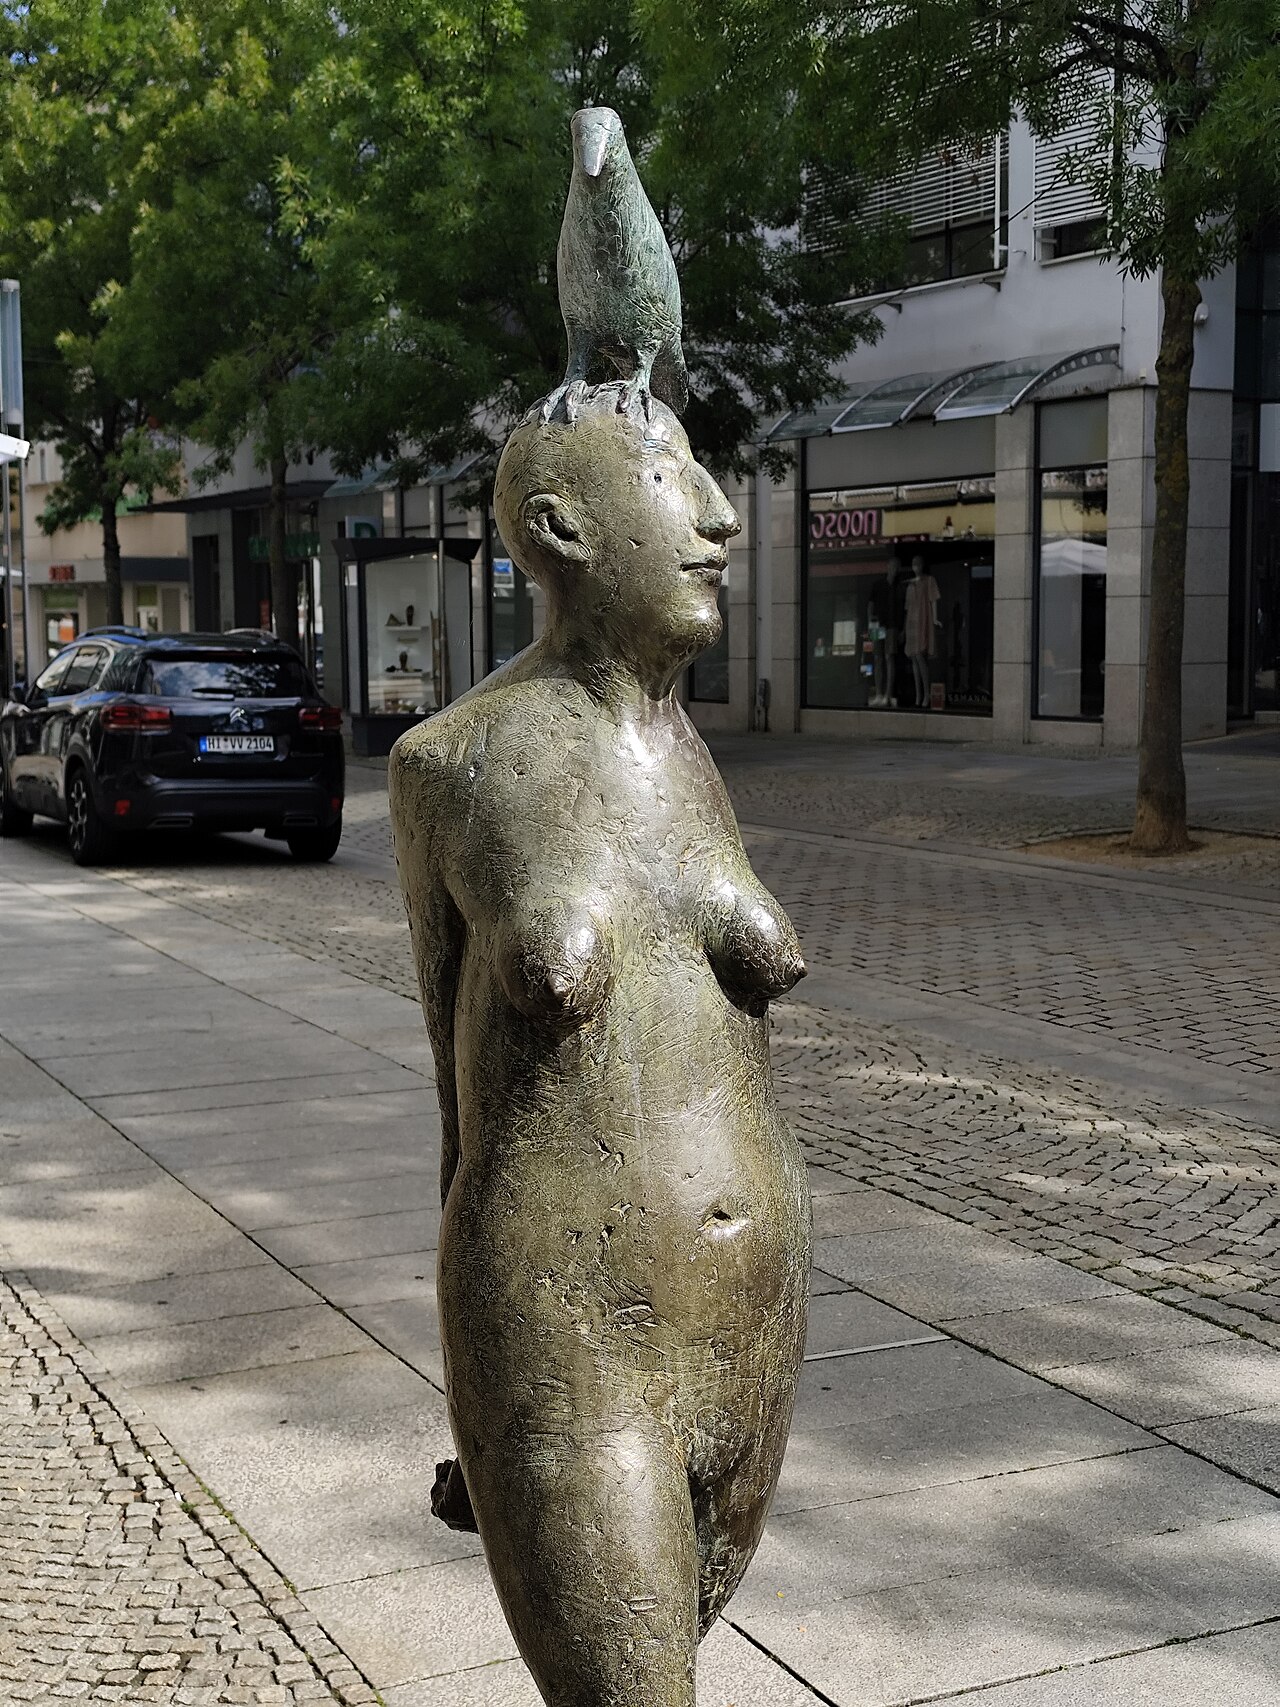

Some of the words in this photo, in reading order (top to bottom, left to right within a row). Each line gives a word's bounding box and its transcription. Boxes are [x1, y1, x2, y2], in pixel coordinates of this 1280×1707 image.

[208, 737, 221, 749] HI
[230, 737, 244, 749] VV
[246, 737, 272, 750] 2104
